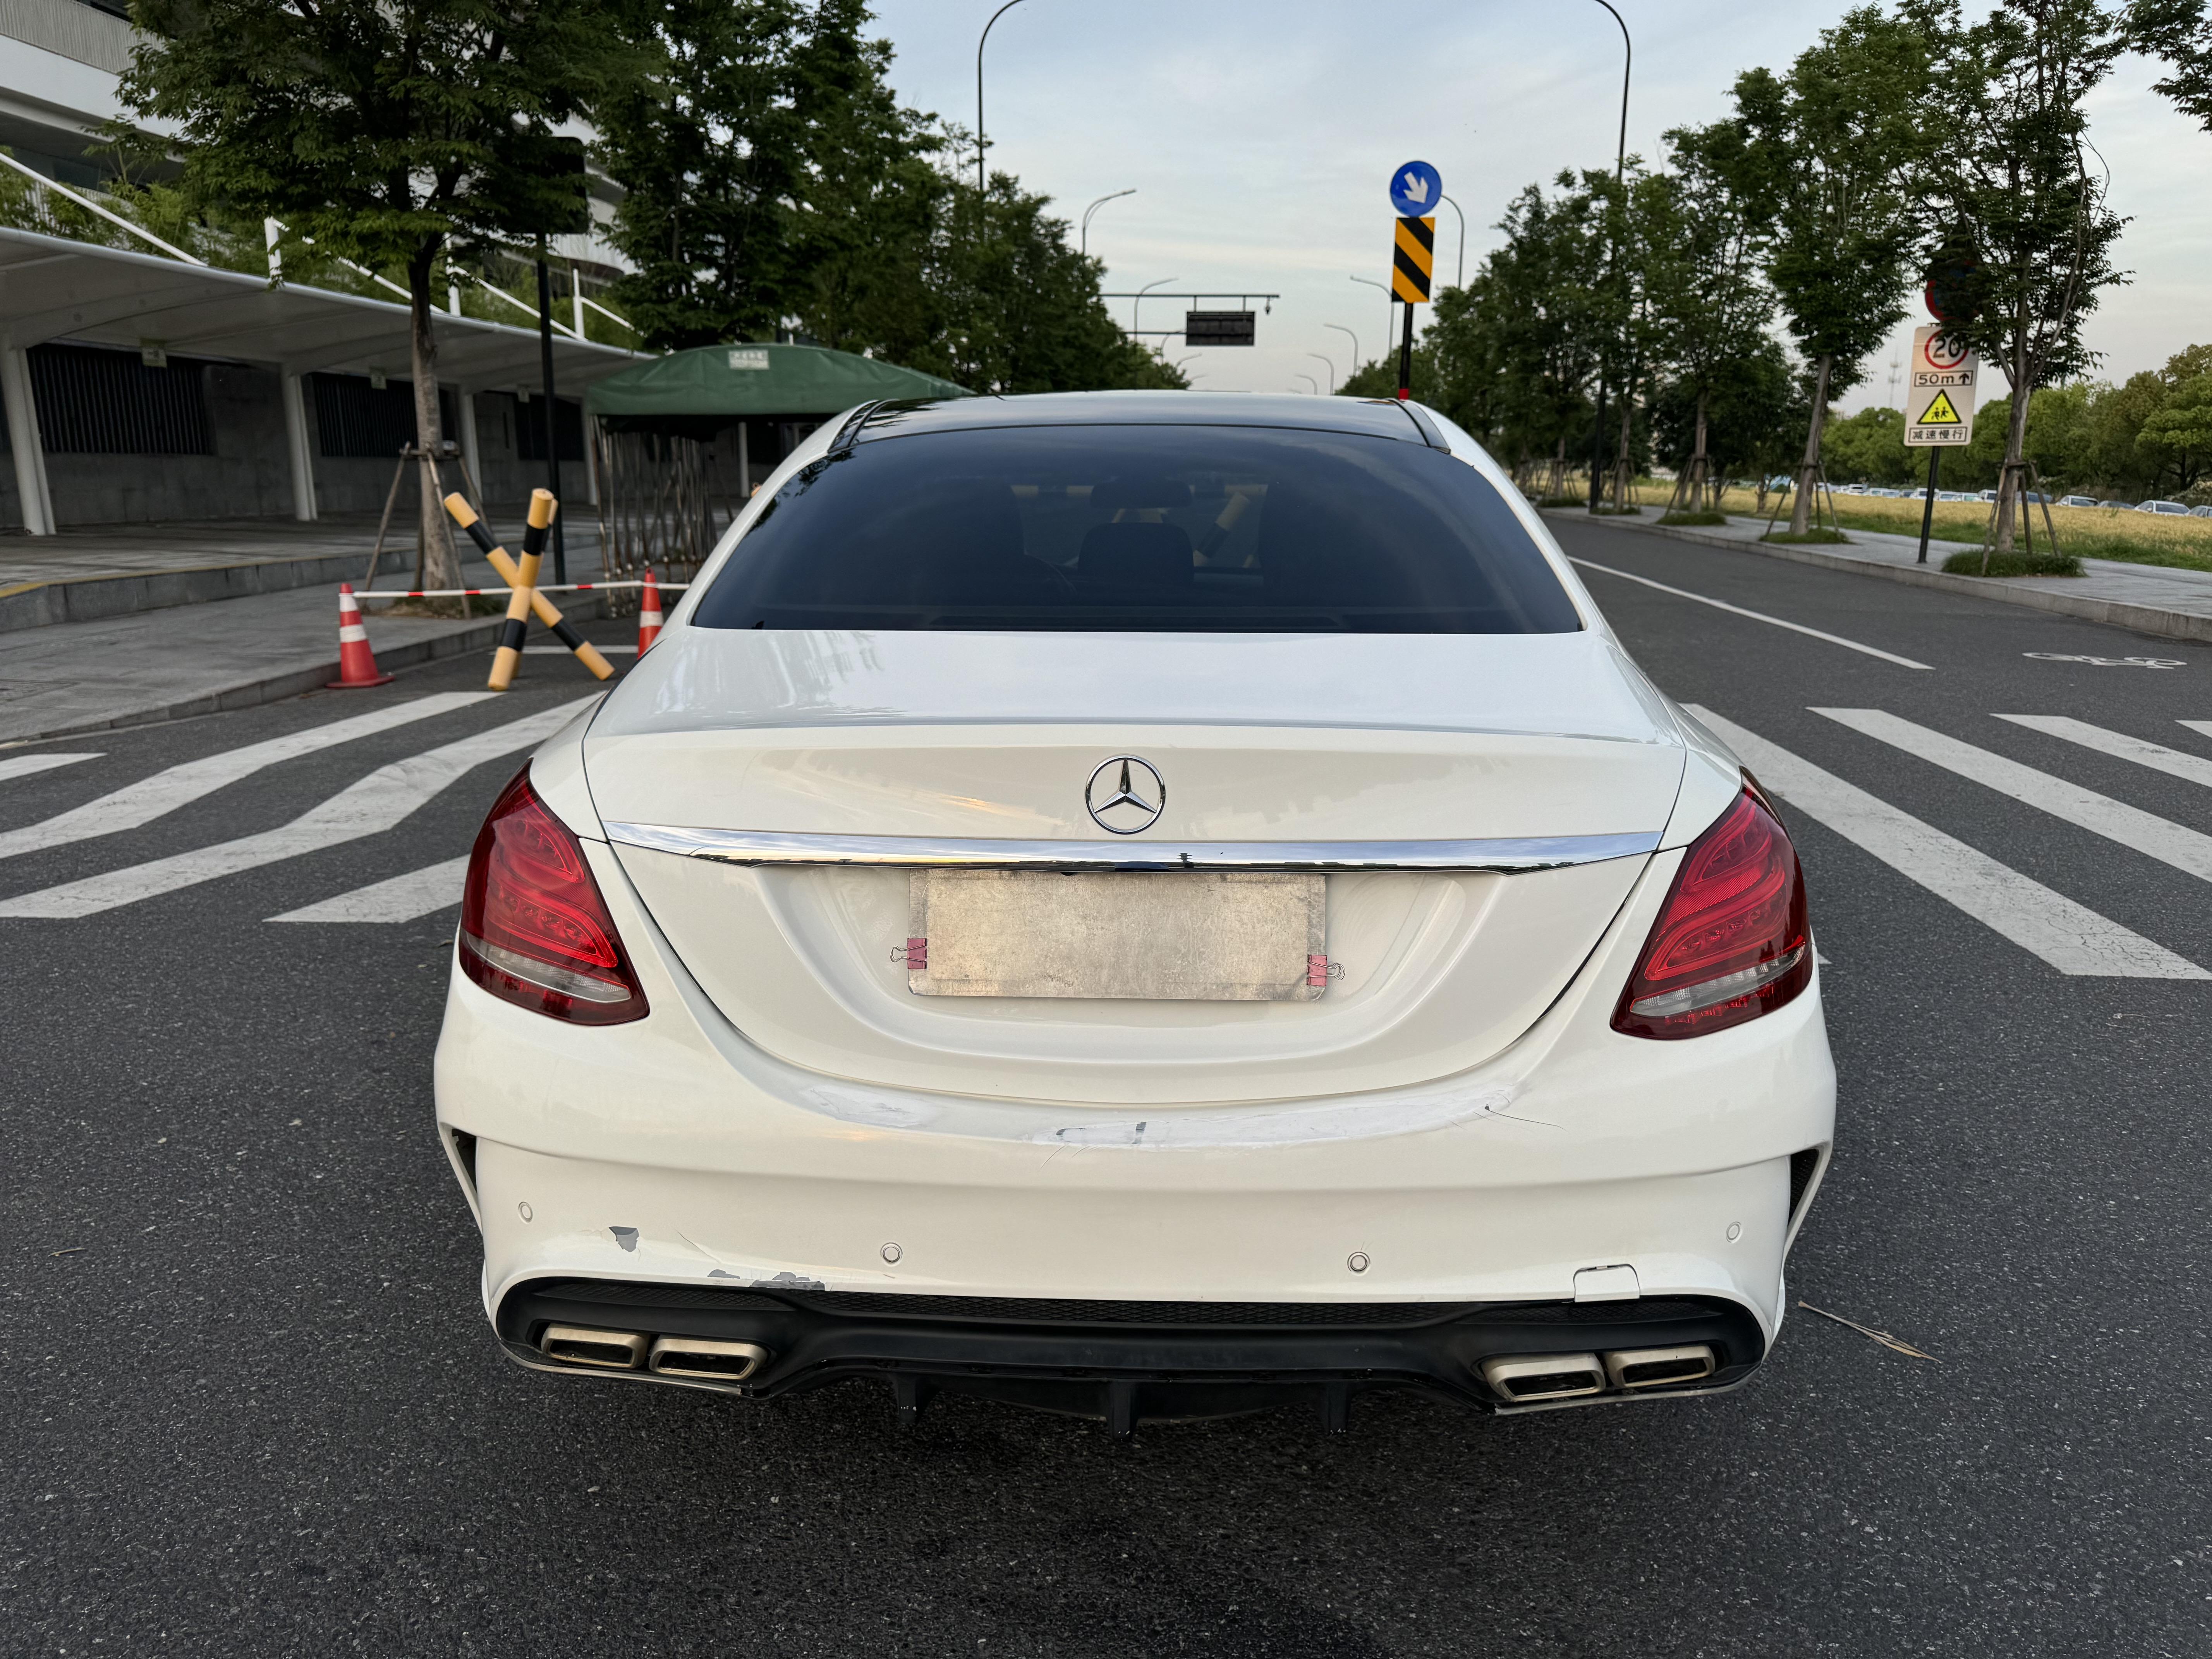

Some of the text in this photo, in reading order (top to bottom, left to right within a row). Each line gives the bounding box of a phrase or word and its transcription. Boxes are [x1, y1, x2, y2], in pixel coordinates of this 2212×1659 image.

[1933, 336, 1960, 358] 20
[1919, 374, 1954, 384] 50m
[1912, 429, 1963, 439] 减速慢行
